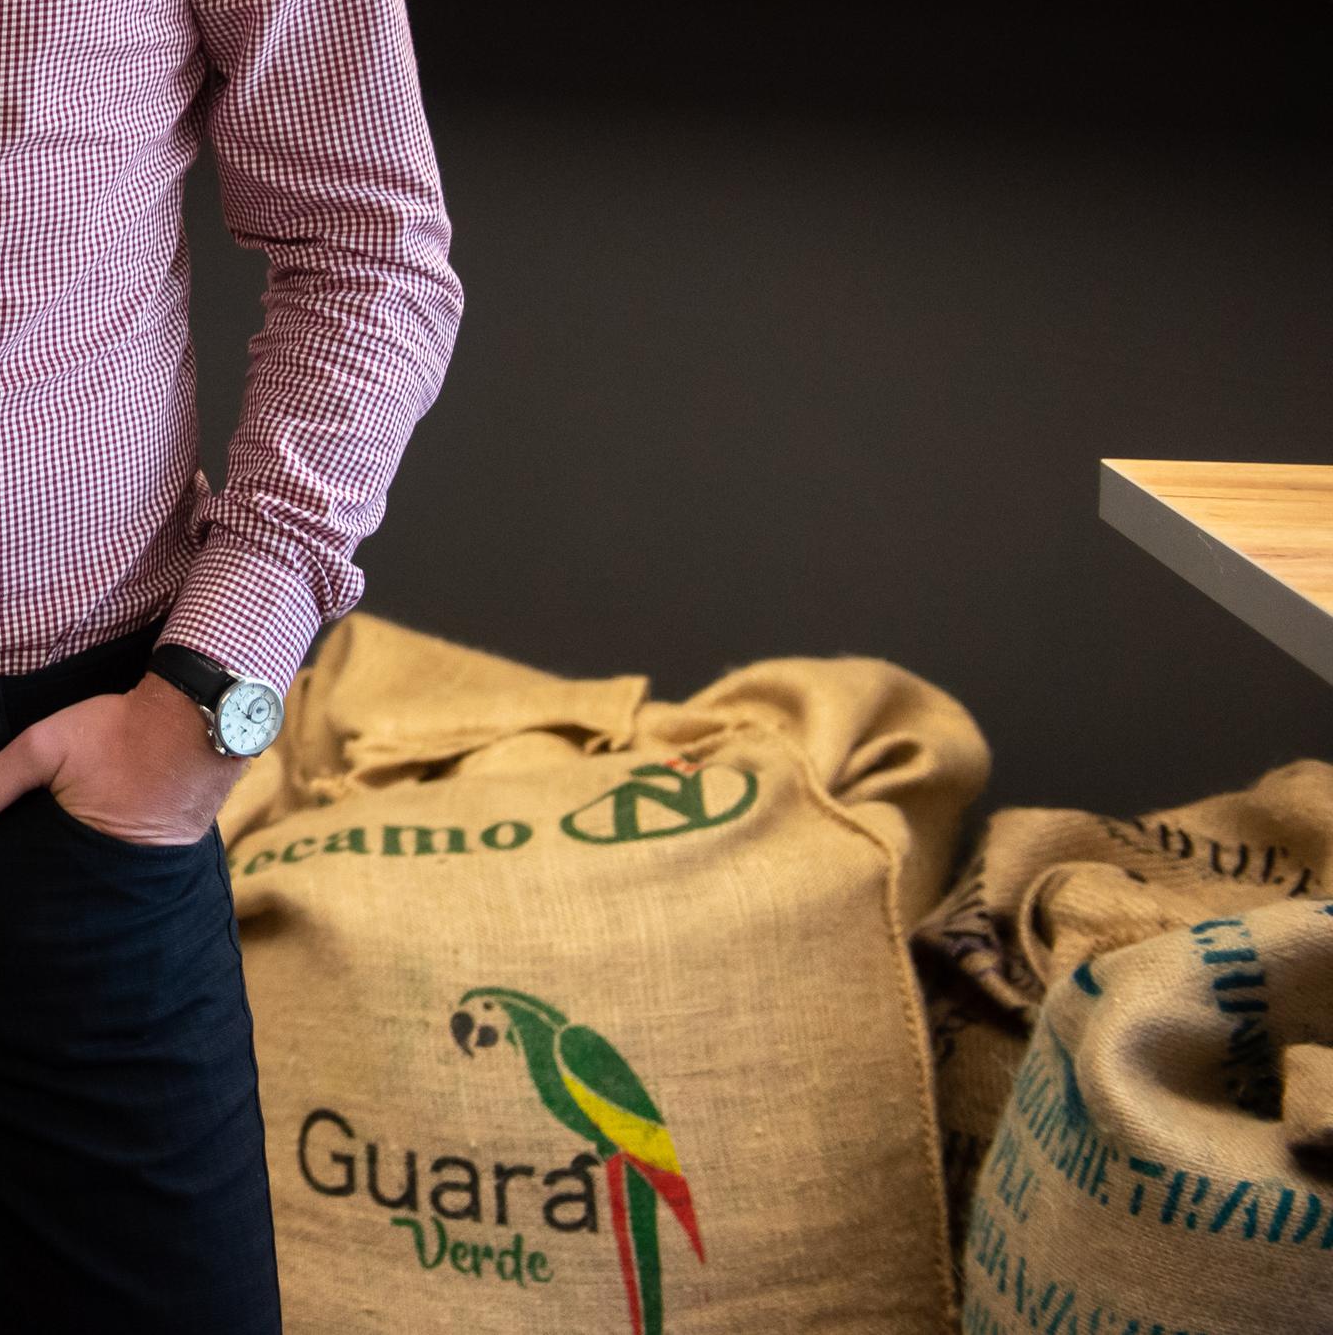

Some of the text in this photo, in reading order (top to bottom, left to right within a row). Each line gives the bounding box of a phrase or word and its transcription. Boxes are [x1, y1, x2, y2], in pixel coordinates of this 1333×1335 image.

[227, 819, 534, 877] ecamo
[1129, 1155, 1333, 1251] TRAD
[389, 1215, 555, 1290] Verde
